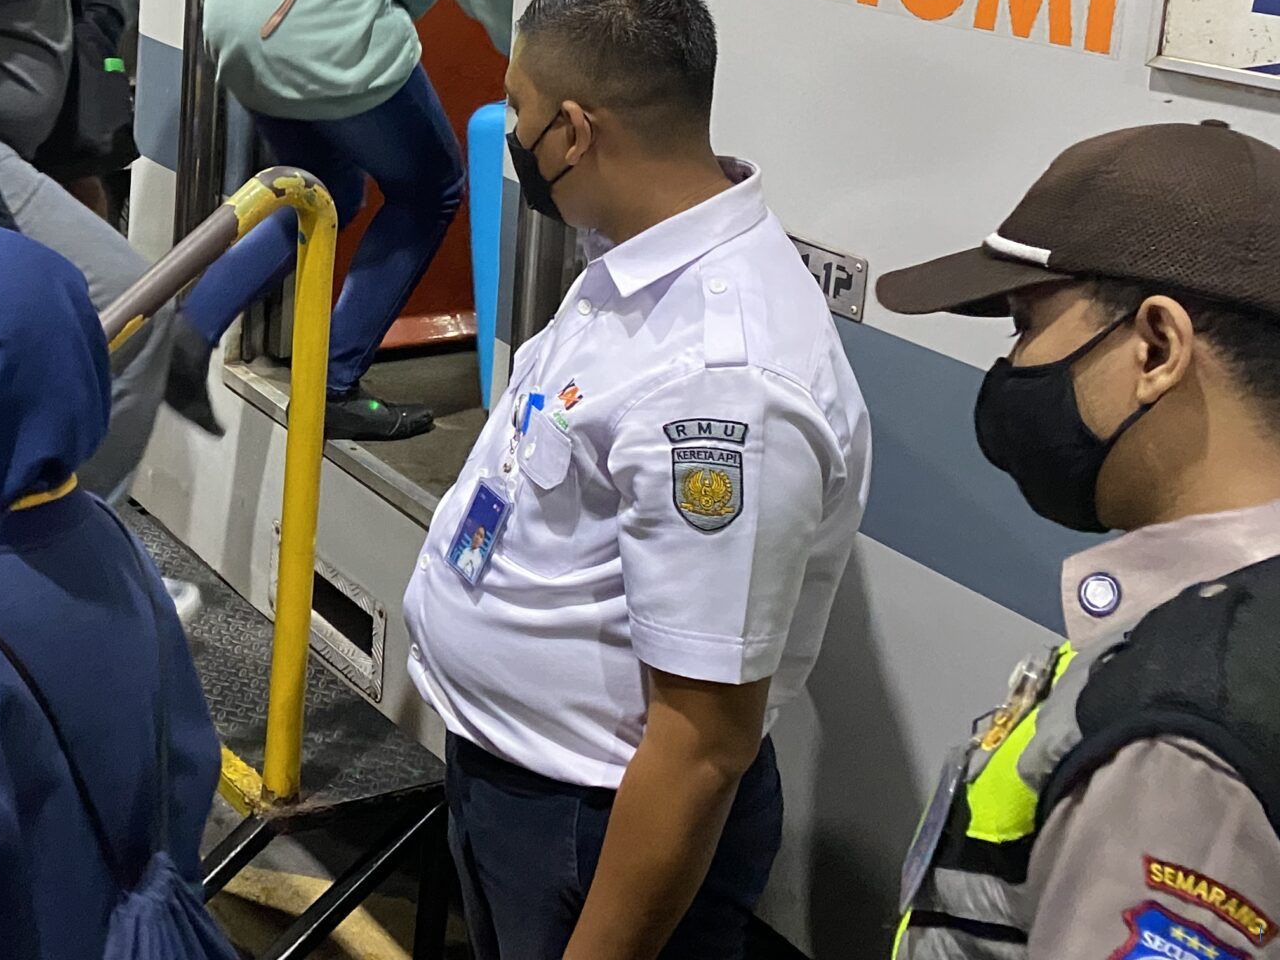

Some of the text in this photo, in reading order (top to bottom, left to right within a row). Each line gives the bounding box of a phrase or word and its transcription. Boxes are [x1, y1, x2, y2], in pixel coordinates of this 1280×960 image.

[676, 450, 737, 464] KERETA API
[1149, 862, 1268, 936] SEMARANG
